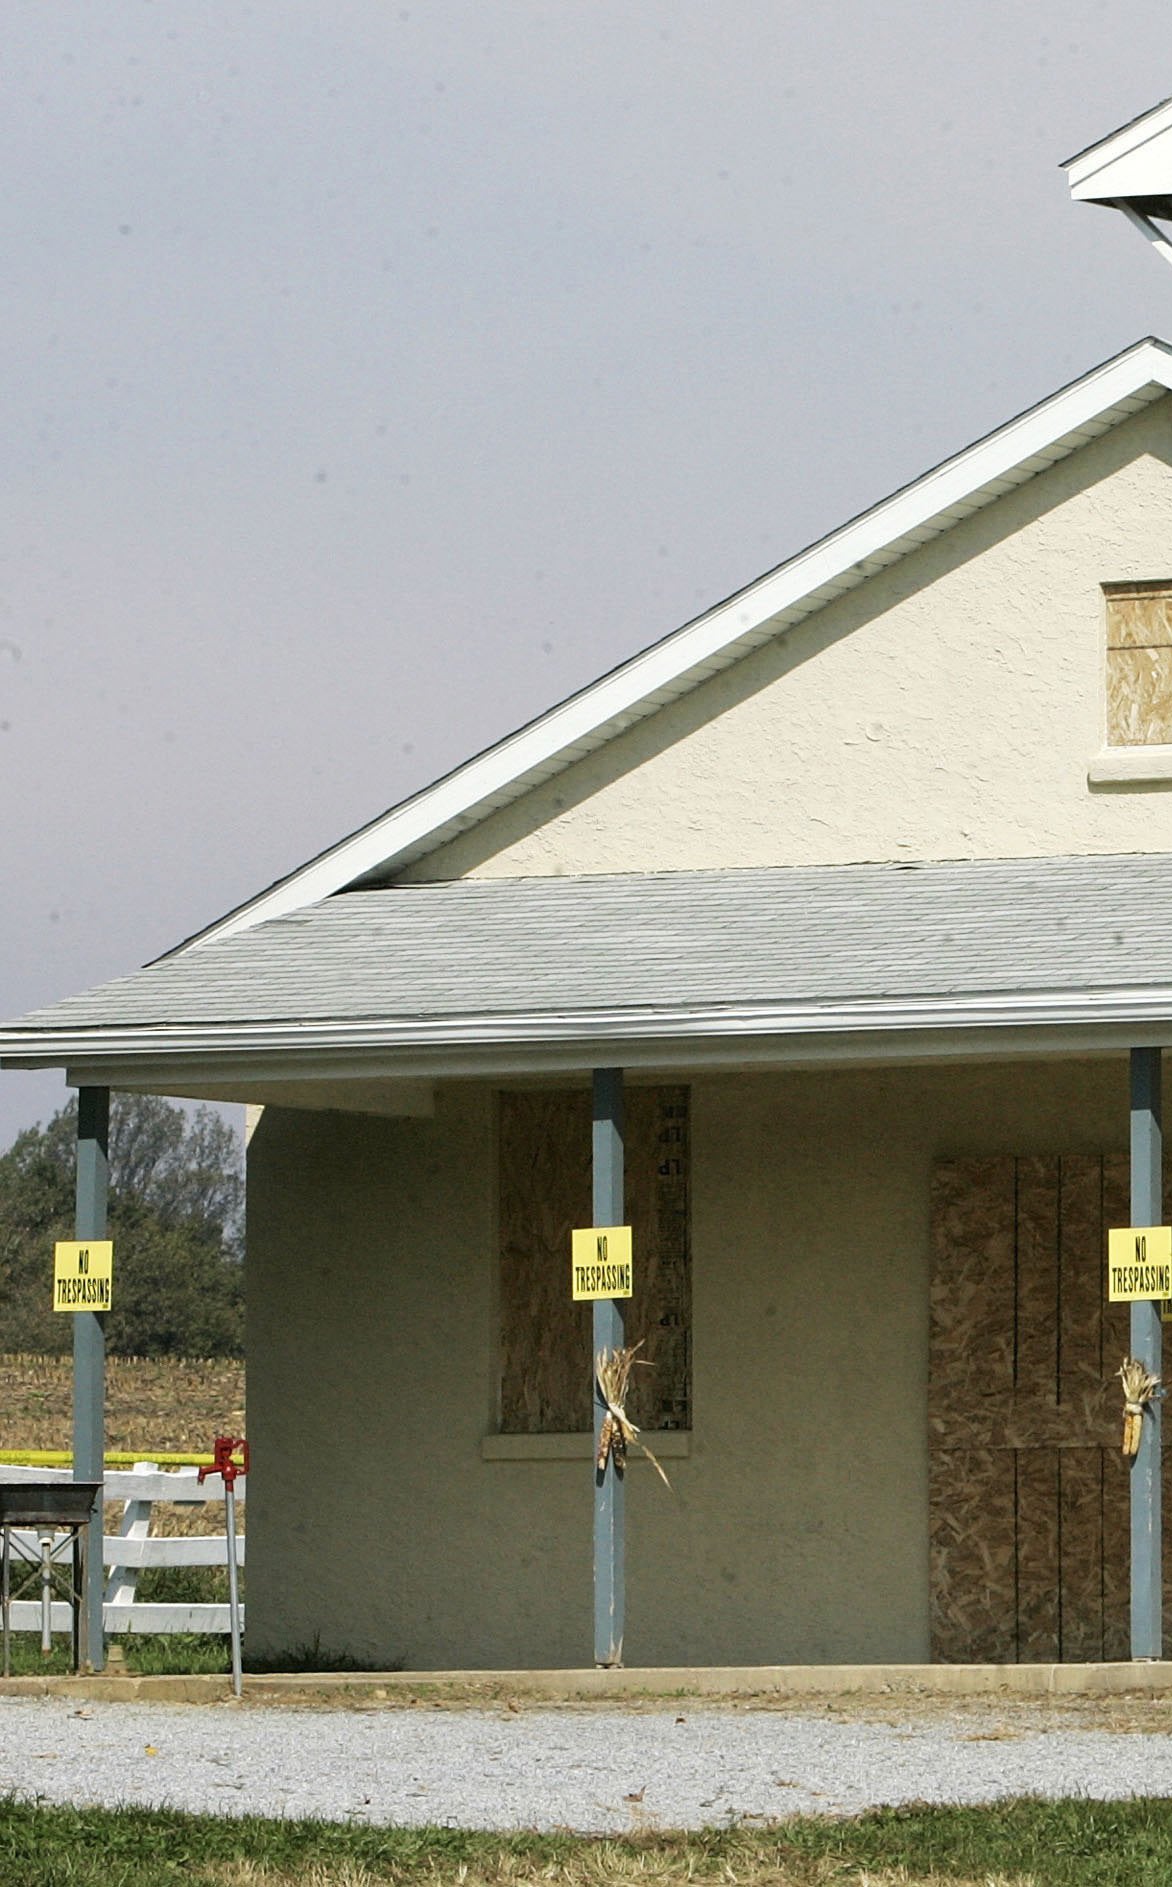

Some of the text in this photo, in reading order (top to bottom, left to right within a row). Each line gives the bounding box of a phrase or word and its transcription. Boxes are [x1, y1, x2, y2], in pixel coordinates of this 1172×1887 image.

[657, 1158, 681, 1175] LP
[78, 1249, 89, 1274] NO
[596, 1236, 608, 1261] NO
[1135, 1235, 1146, 1262] NO
[57, 1278, 110, 1304] TRESPASSING
[575, 1264, 631, 1292] TRESPASSING
[1112, 1265, 1170, 1293] TRESPASSING
